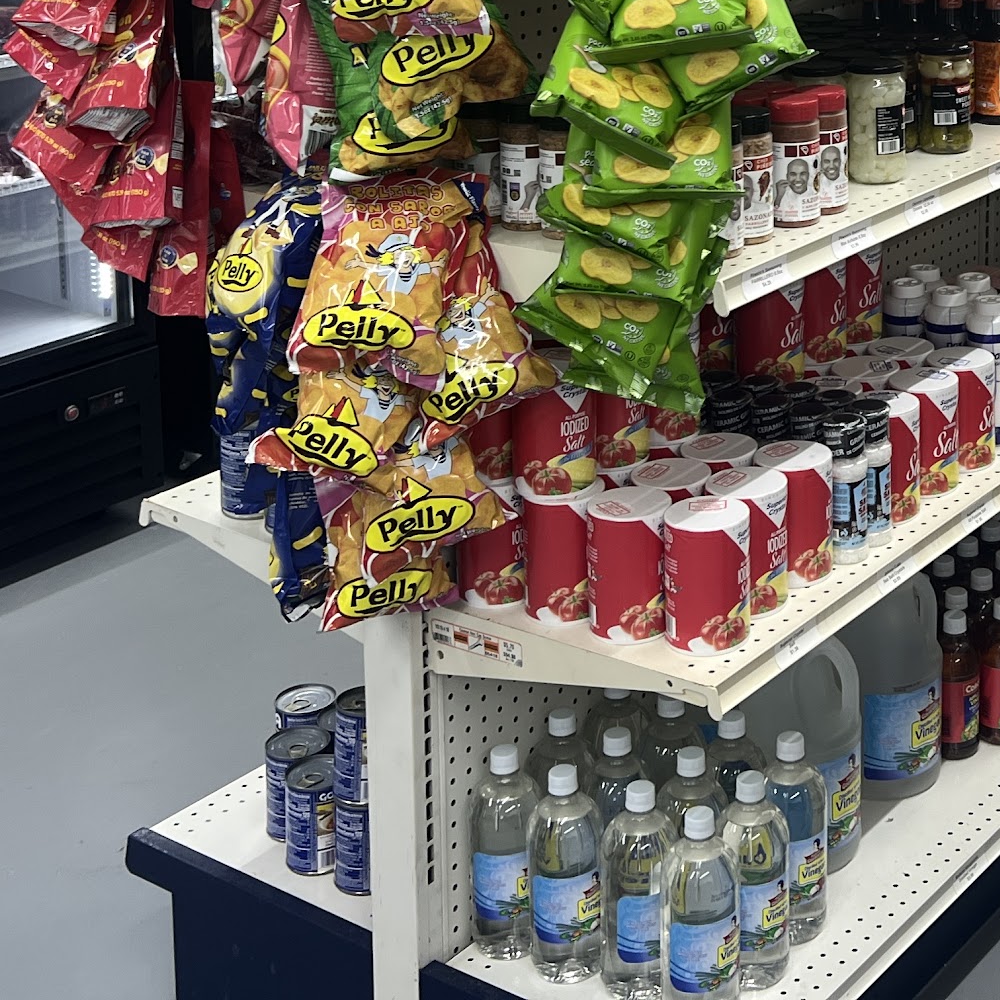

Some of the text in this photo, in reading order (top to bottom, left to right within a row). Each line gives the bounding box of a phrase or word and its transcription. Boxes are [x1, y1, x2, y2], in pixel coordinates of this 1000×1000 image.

[401, 32, 475, 72] Pelly
[350, 185, 444, 200] BOLITAS
[221, 263, 258, 288] Pelly
[859, 279, 883, 308] Salt
[317, 314, 400, 350] Pelly
[431, 369, 505, 414] Pelly
[560, 416, 589, 437] IODIZED
[628, 404, 645, 424] Salt
[289, 422, 366, 468] Pelly
[563, 434, 586, 452] Salt
[933, 428, 959, 458] Salt
[376, 503, 458, 542] Pelly
[349, 577, 420, 608] Pelly
